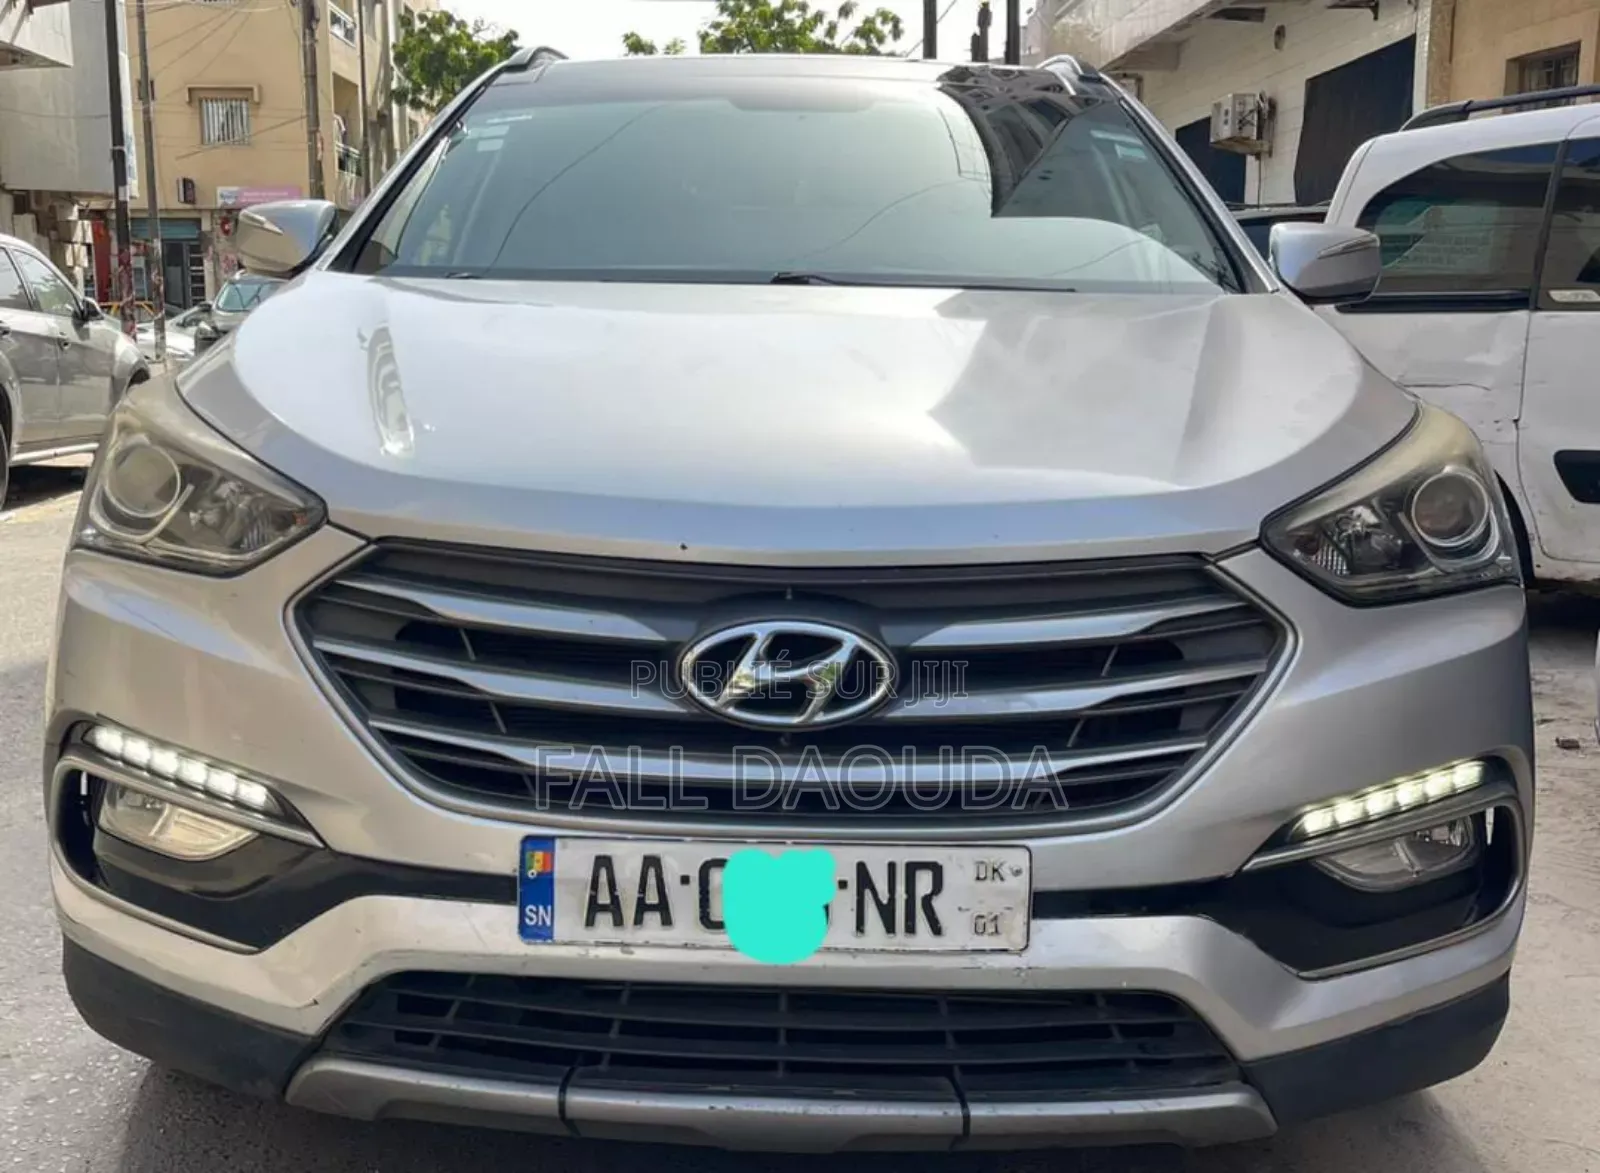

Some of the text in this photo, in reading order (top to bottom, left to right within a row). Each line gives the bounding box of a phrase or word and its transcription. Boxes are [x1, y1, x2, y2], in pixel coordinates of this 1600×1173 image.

[974, 860, 1007, 882] DK
[525, 903, 551, 926] SN
[974, 913, 1002, 936] 01
